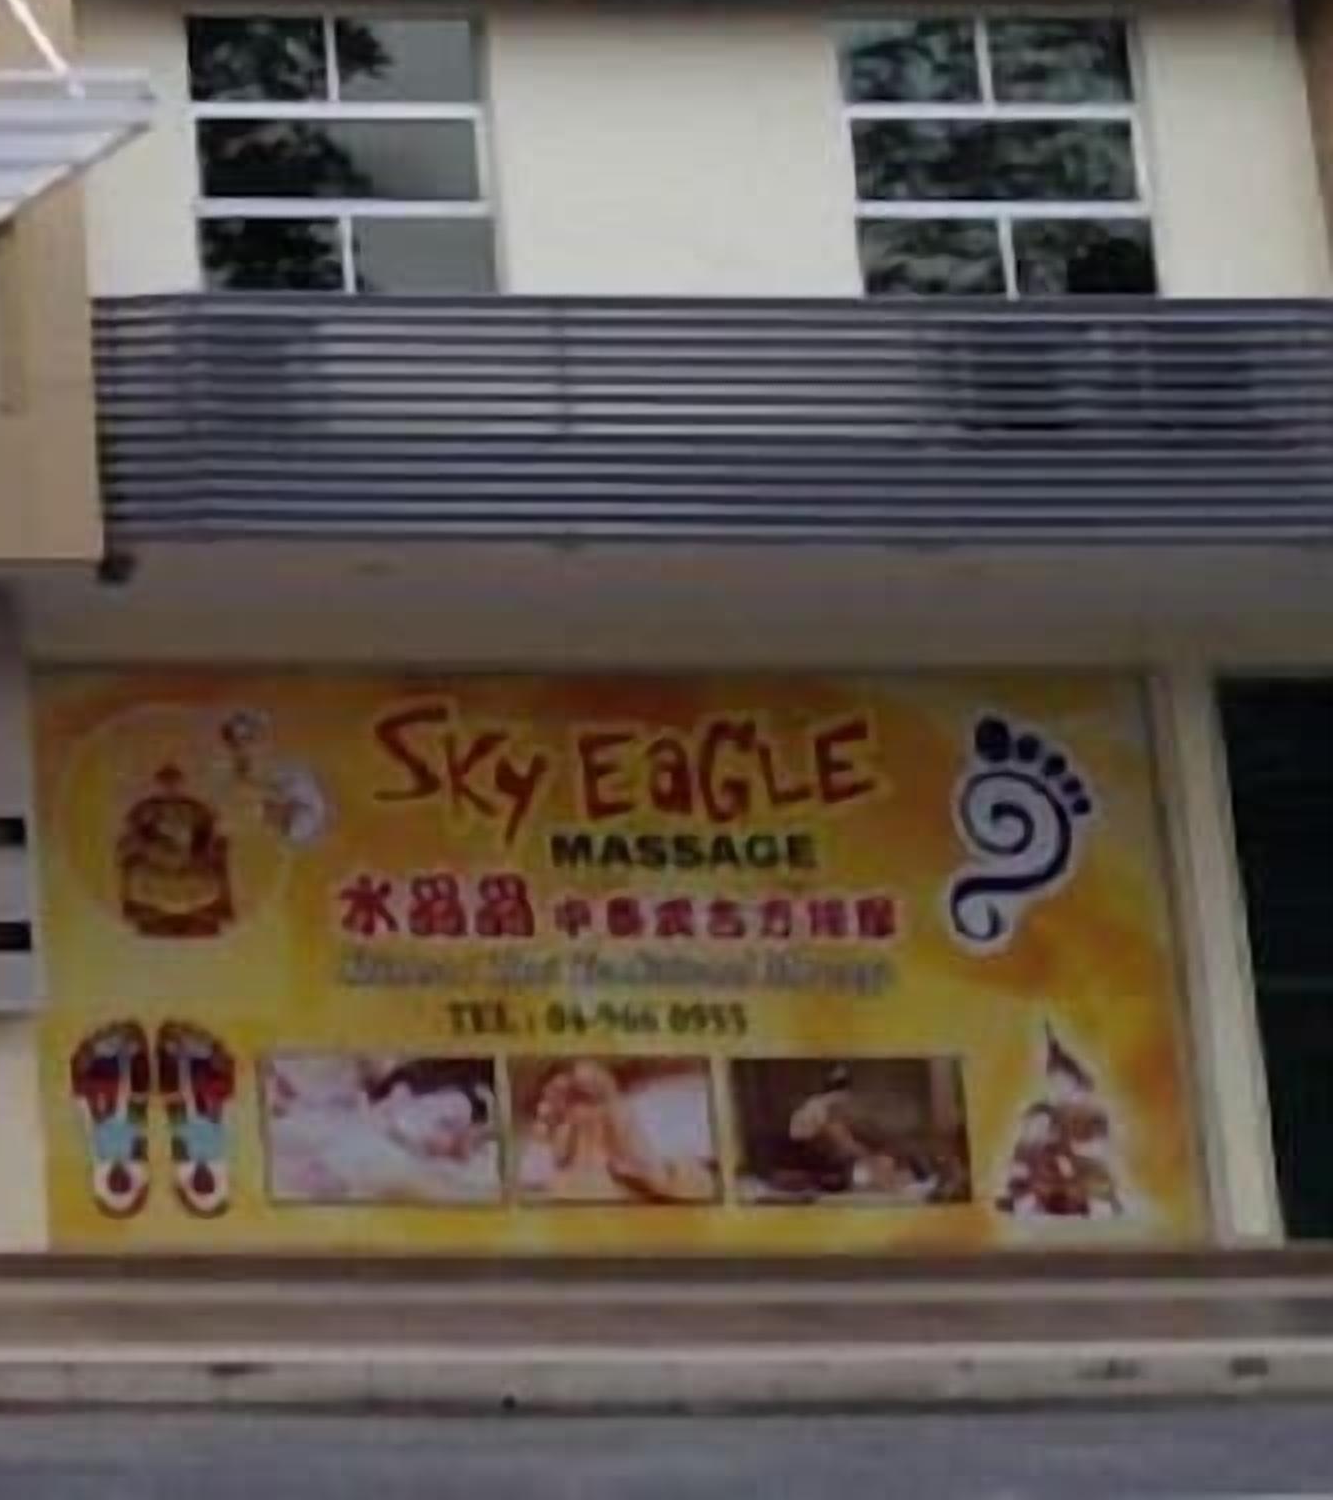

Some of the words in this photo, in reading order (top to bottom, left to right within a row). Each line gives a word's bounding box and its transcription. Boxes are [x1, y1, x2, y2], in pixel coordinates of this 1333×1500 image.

[549, 833, 818, 869] MASSAGE
[339, 873, 535, 938] 水晶晶
